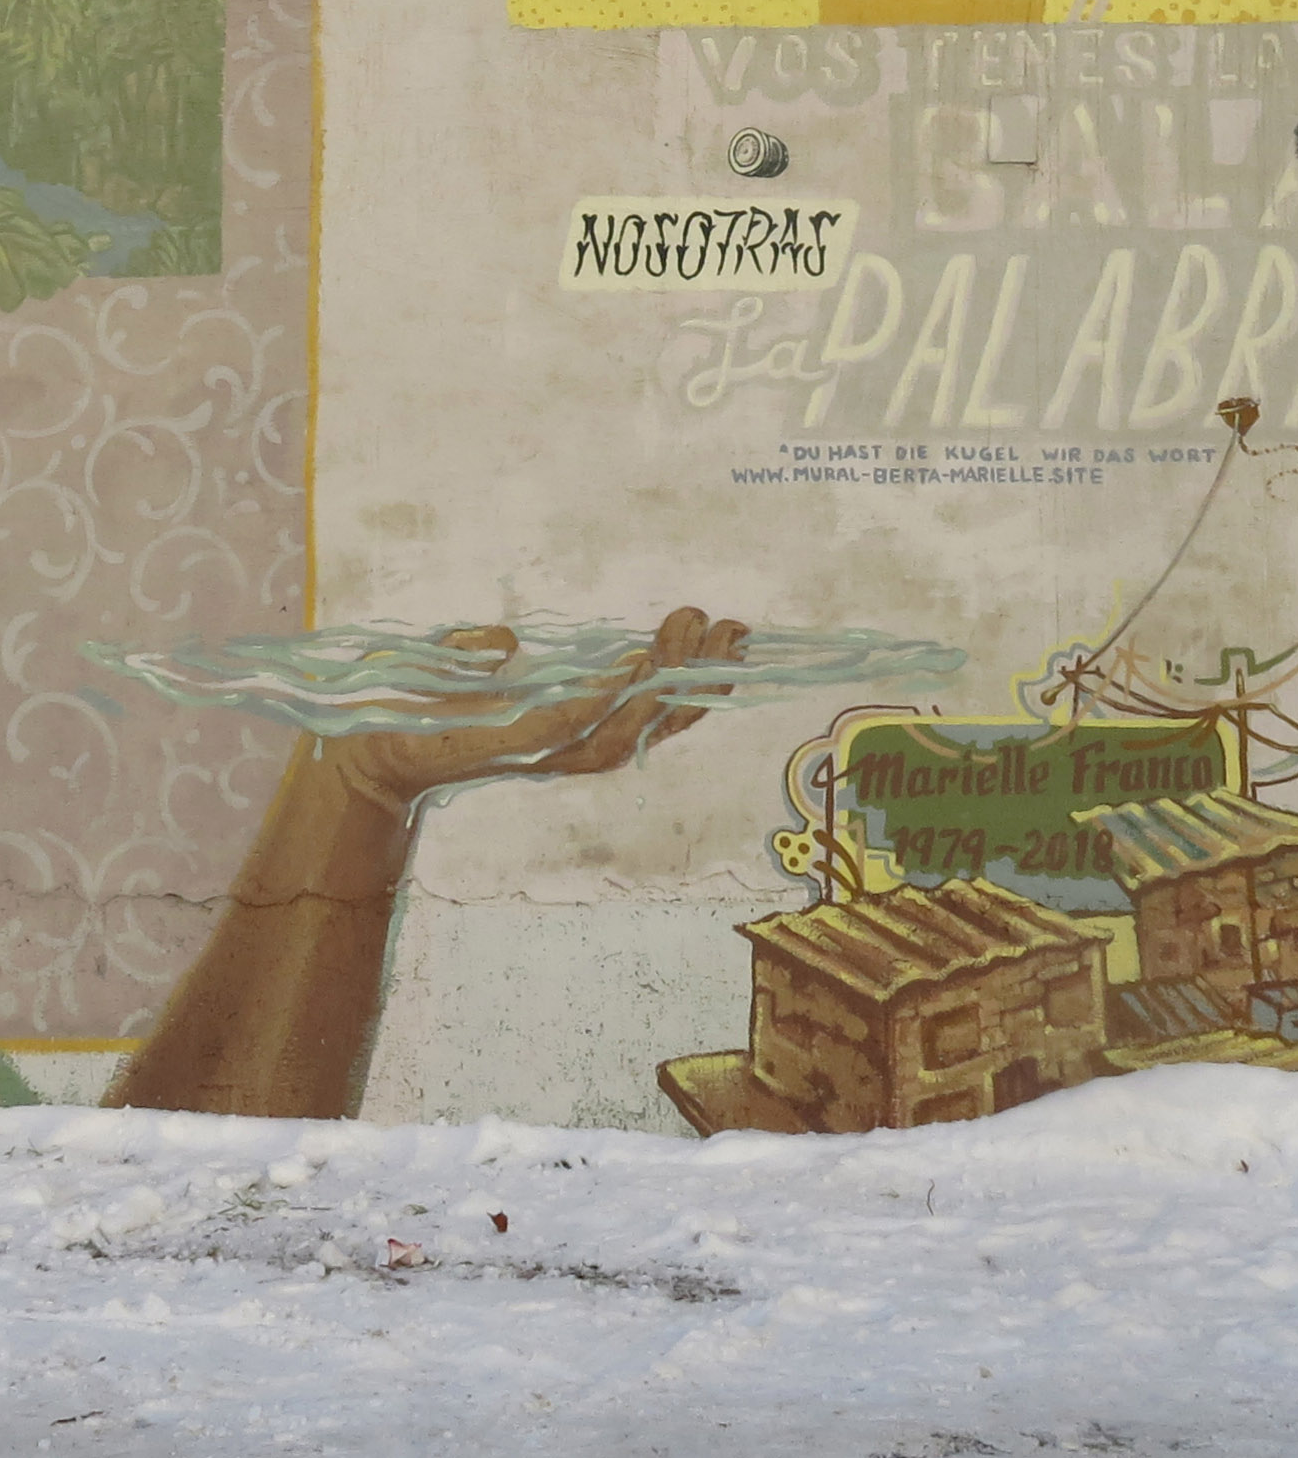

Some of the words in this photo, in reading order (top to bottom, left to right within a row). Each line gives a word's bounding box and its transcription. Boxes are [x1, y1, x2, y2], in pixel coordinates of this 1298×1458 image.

[698, 32, 868, 94] VOS
[573, 206, 843, 279] NOSOTRAS
[731, 466, 1103, 485] WWW.MURAL-BERTA-MARIELLE.SITE
[829, 444, 882, 461] HAST
[896, 445, 928, 461] DIE
[945, 446, 1019, 462] KUGEL
[1041, 447, 1081, 463] WIR
[1094, 448, 1135, 463] DAS
[1148, 448, 1217, 464] WORT
[851, 745, 1050, 800] Marielle
[1068, 742, 1214, 794] Franco
